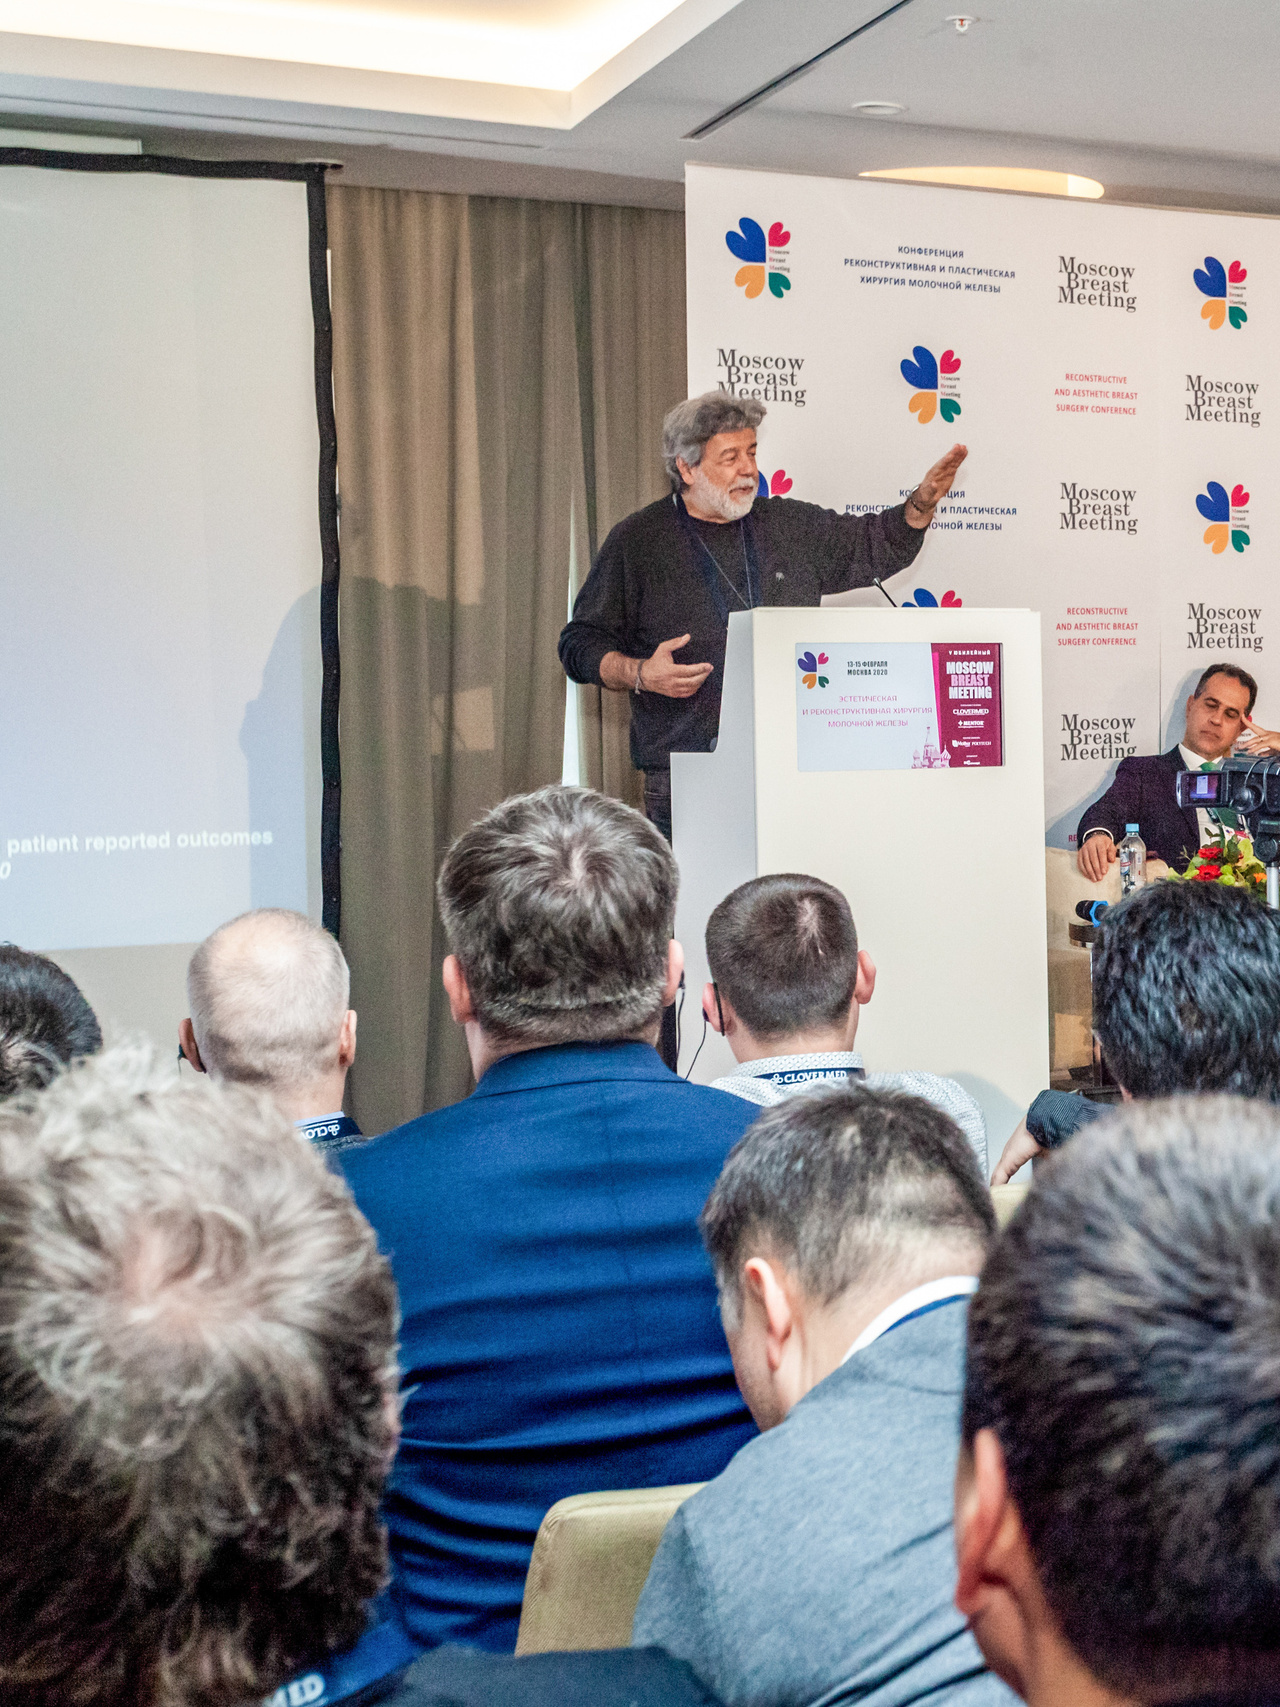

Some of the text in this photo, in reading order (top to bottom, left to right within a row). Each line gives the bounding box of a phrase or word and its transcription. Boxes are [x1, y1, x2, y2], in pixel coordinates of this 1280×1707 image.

[898, 246, 964, 259] КОНФЕРЕНЦИЯ
[844, 258, 936, 273] РЕКОНСТРУКТИВНАЯ
[948, 266, 1015, 278] ПЛАСТИЧЕСКАЯ
[1058, 256, 1136, 279] Moscow
[860, 276, 1000, 293] ХИРУРГИЯ МОЛОЧНОЙ ЖЕЛЕЗЫ
[1066, 272, 1129, 292] Breast
[1058, 286, 1136, 312] Meeting
[717, 349, 805, 371] Moscow
[726, 366, 798, 385] Breast
[1065, 373, 1127, 384] RECONSTRUCTIVE
[1186, 375, 1260, 395] Moscow
[1073, 390, 1109, 398] AESTHETIC
[1194, 390, 1253, 408] Breast
[1056, 404, 1136, 415] SURGERY CONFERENCE
[1185, 405, 1261, 427] Meeting
[1060, 482, 1137, 502] Moscow
[1068, 498, 1130, 515] Breast
[1060, 513, 1138, 534] Meeting
[1188, 603, 1263, 620] Moscow
[1196, 618, 1256, 634] Breast
[1187, 633, 1264, 652] Meeting
[946, 661, 994, 674] MOSCOW
[951, 674, 989, 686] BREAST
[949, 686, 992, 699] MEETING
[1061, 714, 1136, 731] Moscow
[1069, 728, 1130, 745] Breast
[7, 830, 273, 857] patient reported outcomes
[784, 1071, 847, 1083] CLOVERMED
